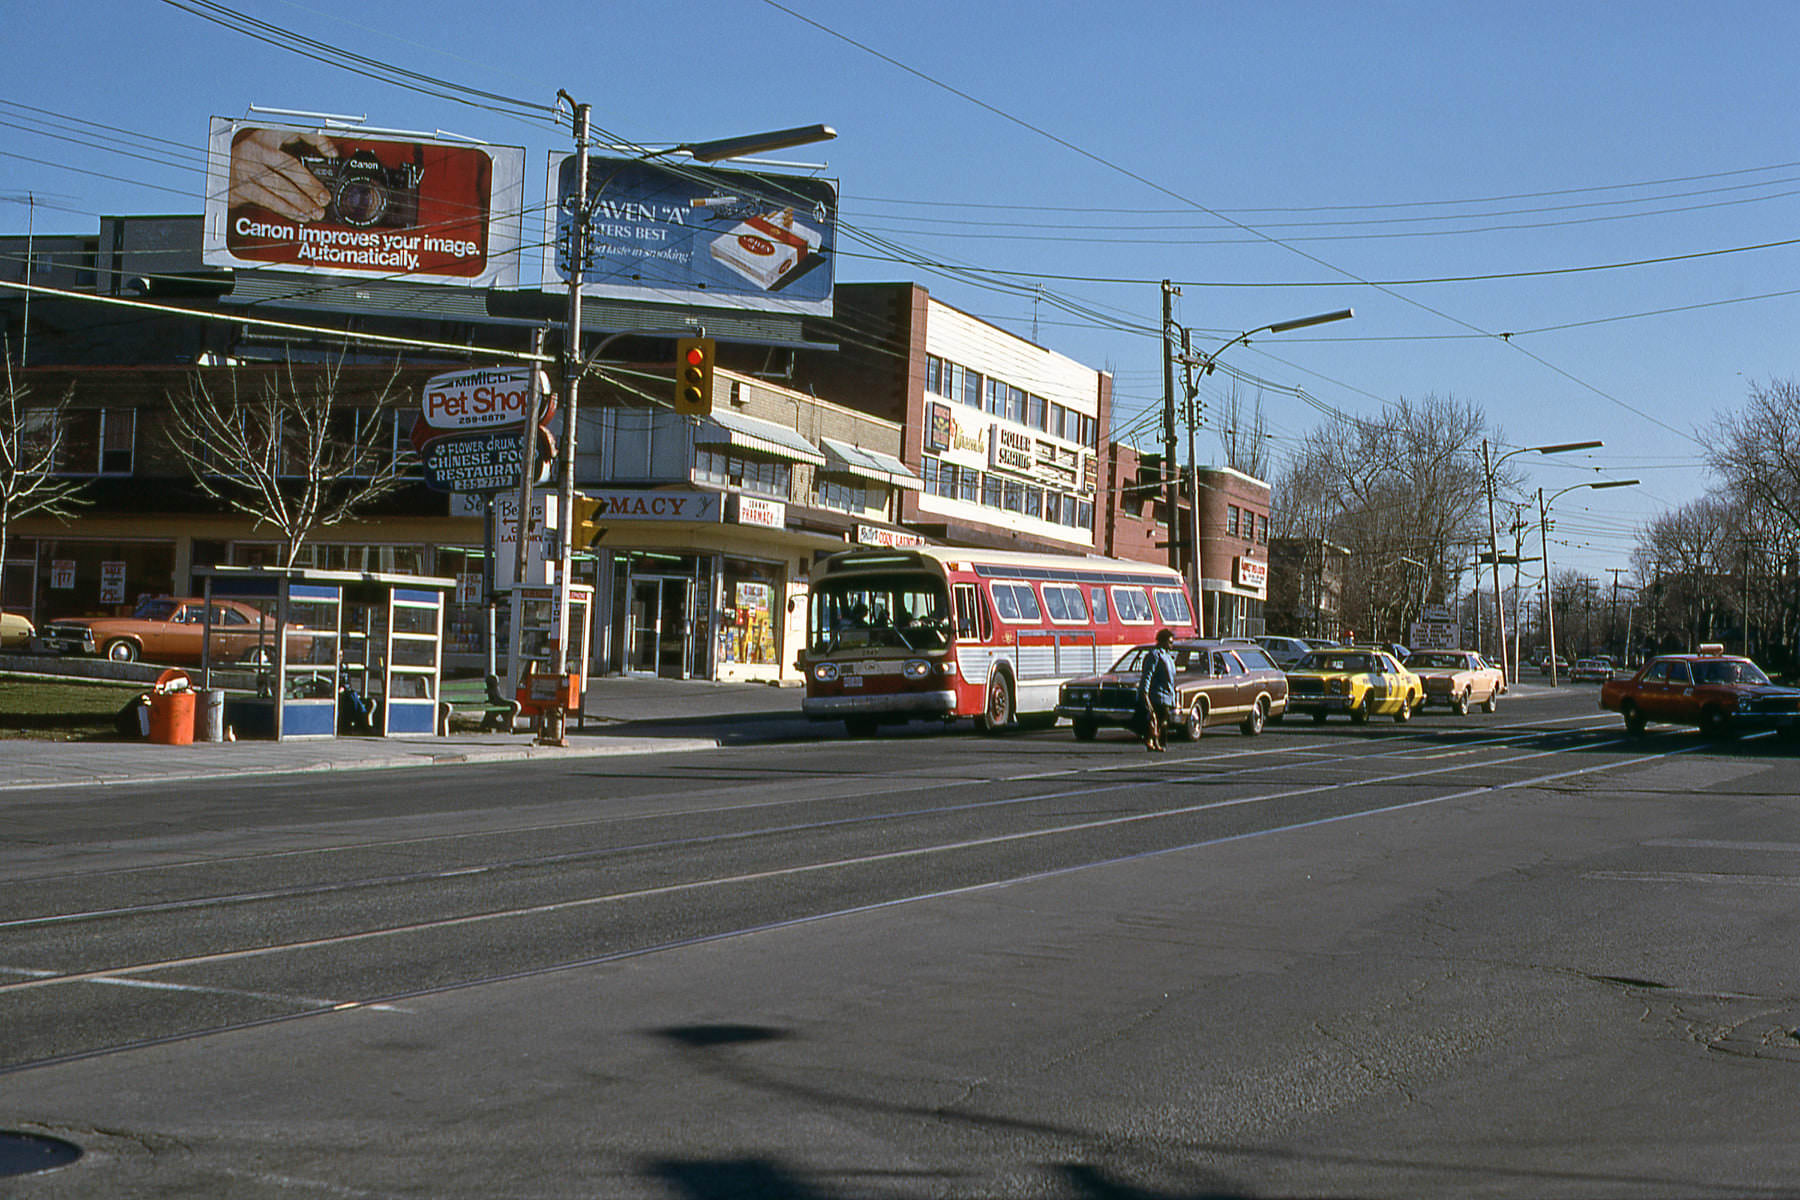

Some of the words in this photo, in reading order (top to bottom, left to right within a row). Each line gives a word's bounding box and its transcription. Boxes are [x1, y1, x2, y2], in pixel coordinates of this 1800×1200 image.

[350, 159, 379, 170] Canon
[562, 196, 656, 223] CAVEN
[235, 217, 294, 241] Canon
[298, 223, 380, 247] improves
[383, 234, 421, 251] your
[424, 234, 481, 257] image.
[635, 226, 668, 241] BEST
[298, 242, 420, 270] Automatically.
[428, 391, 468, 418] Pet
[448, 440, 485, 455] FLOWER
[1001, 429, 1031, 453] ROLLER
[428, 452, 491, 470] CHINESE
[999, 447, 1032, 472] SKATING
[437, 462, 523, 481] RESTAURAN
[742, 507, 774, 525] PHARMACY
[879, 530, 893, 546] COIN
